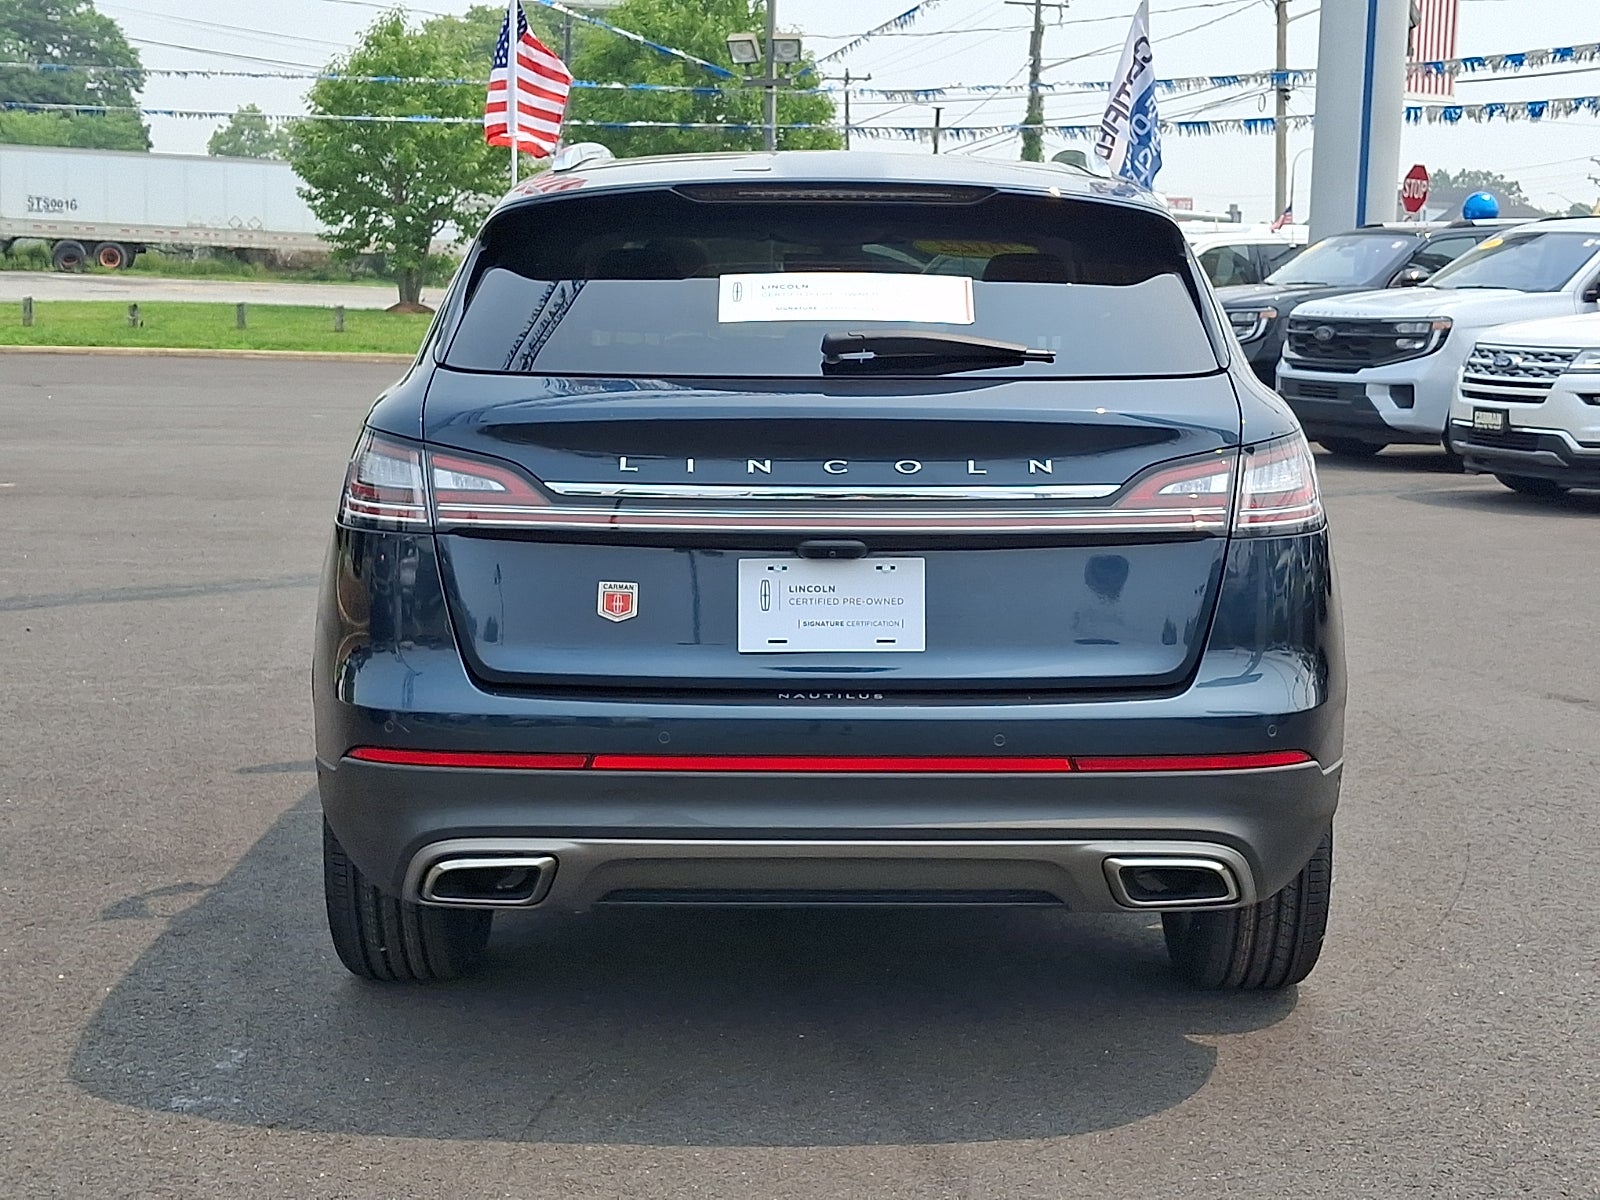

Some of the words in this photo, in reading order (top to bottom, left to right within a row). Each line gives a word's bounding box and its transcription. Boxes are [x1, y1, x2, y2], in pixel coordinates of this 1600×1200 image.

[1403, 178, 1427, 198] STOP
[619, 457, 1054, 475] LINCOLN
[602, 583, 635, 591] CARMAN
[788, 585, 836, 593] LINCOLN
[788, 597, 840, 606] CERTIFIED
[842, 597, 904, 606] PRE-OWNED
